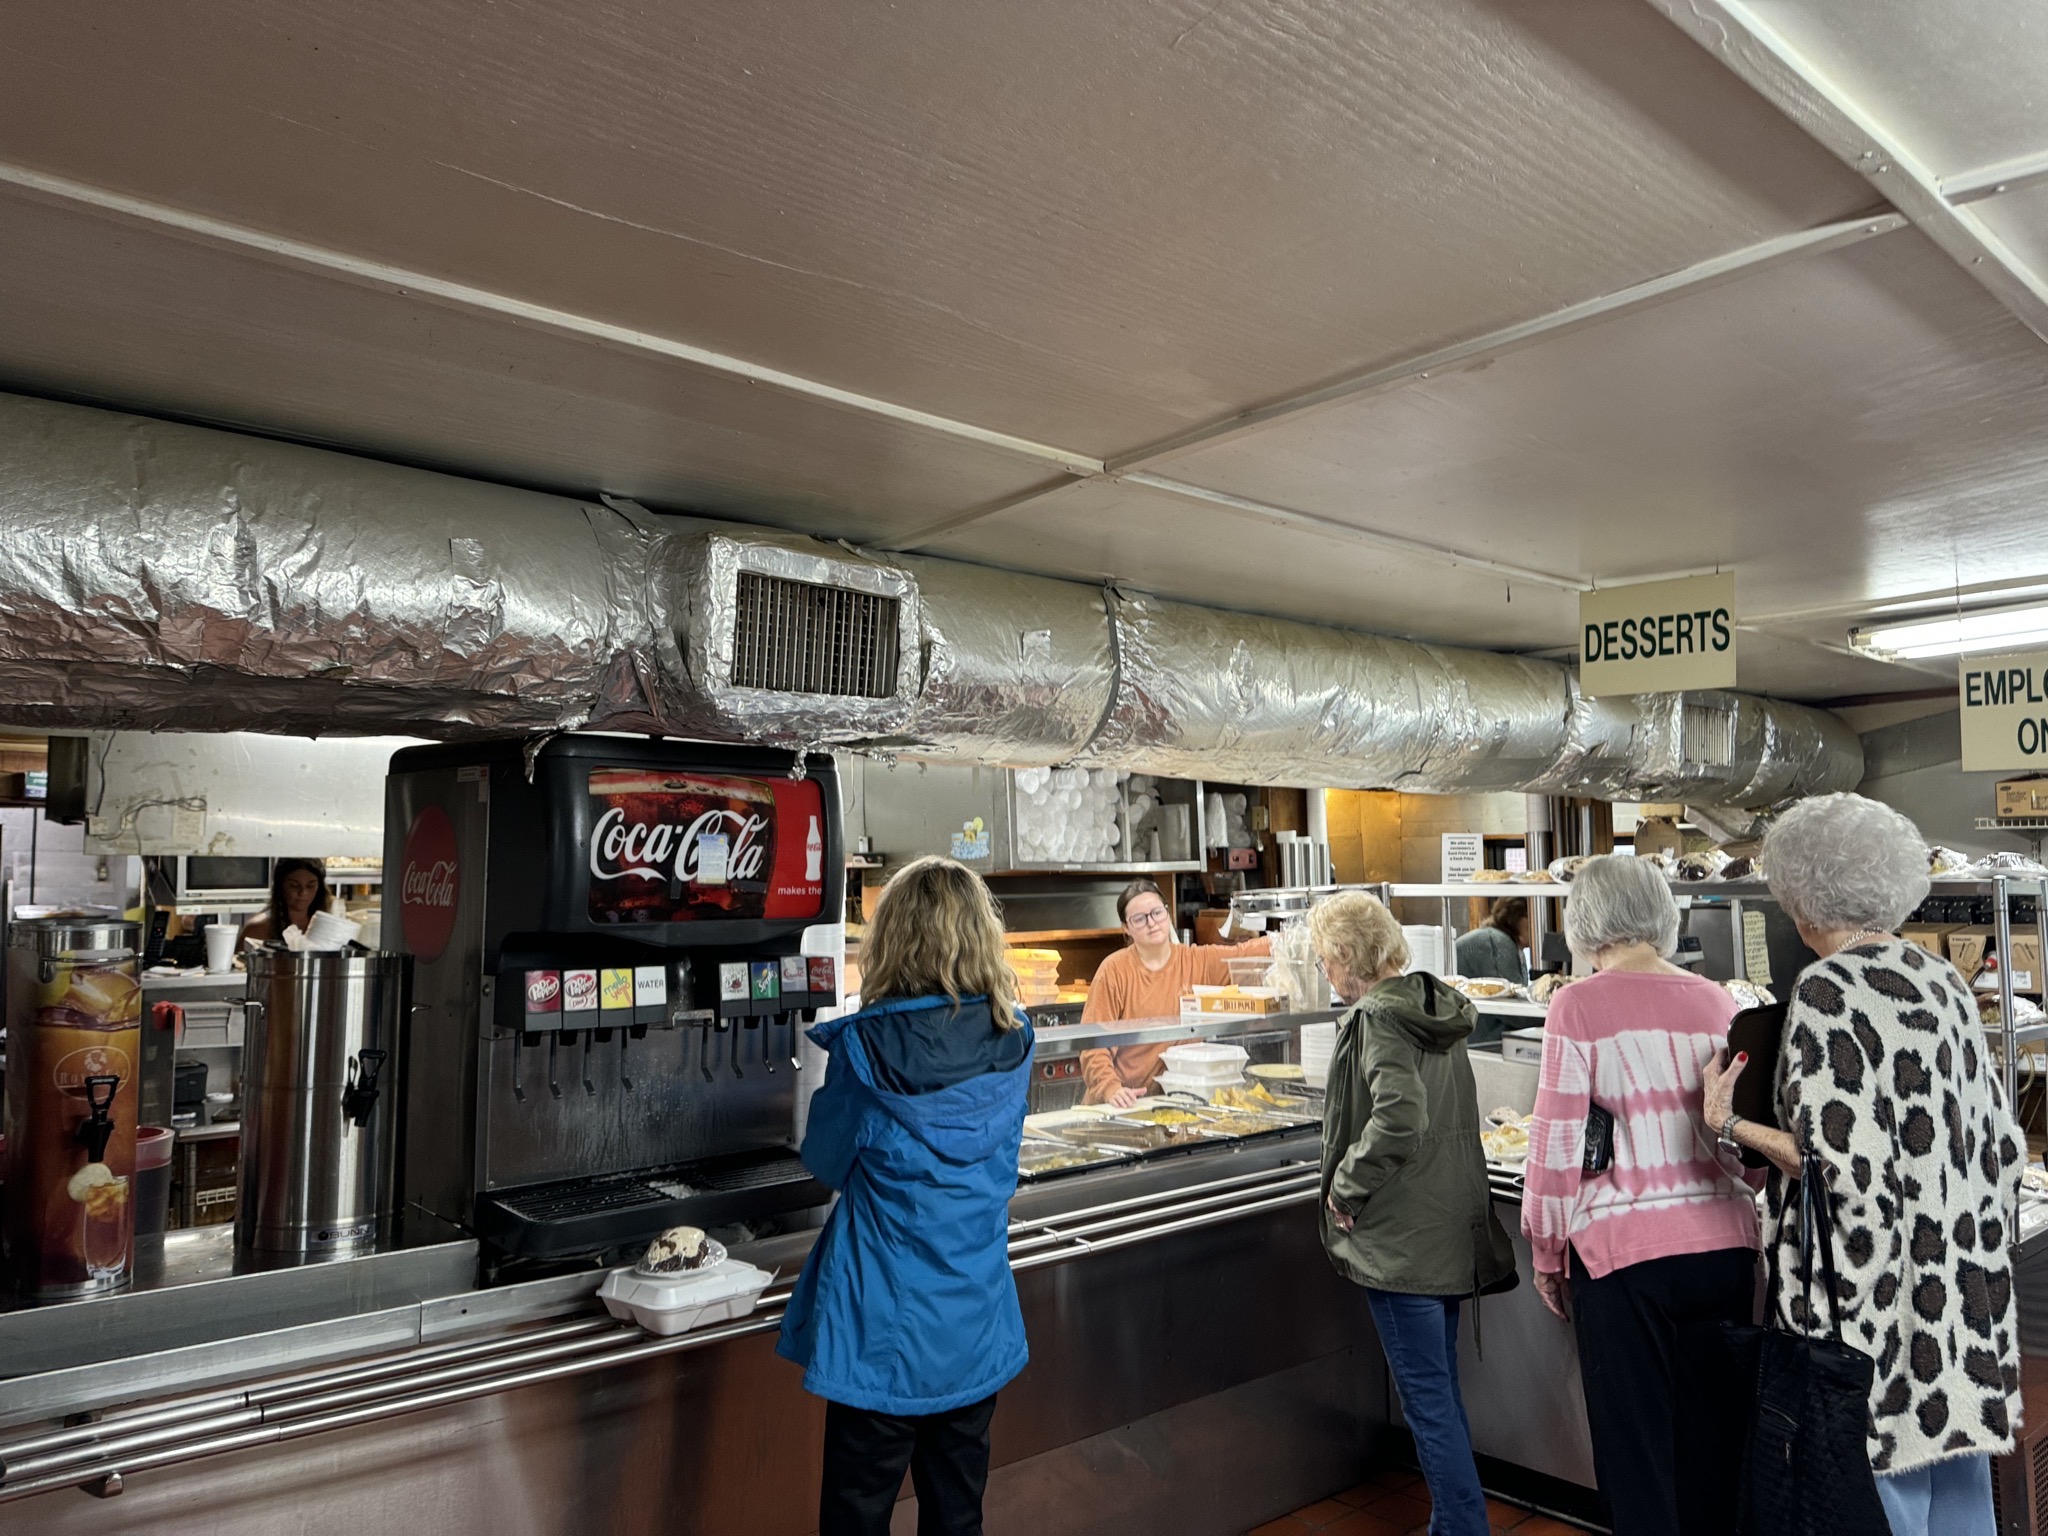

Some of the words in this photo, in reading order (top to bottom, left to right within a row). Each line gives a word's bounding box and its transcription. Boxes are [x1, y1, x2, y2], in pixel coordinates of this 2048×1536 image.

[1585, 608, 1730, 663] DESSERTS
[1966, 667, 2048, 707] EMPL
[590, 807, 768, 882] Coca-Cla
[403, 861, 456, 906] Coca-Cola
[778, 886, 805, 896] makes
[808, 885, 822, 896] the
[530, 980, 558, 1001] Pepper
[540, 978, 551, 989] Dr
[567, 977, 595, 996] Pepper
[603, 973, 628, 995] mello
[637, 979, 664, 989] WATER
[329, 1227, 369, 1239] BUNN
